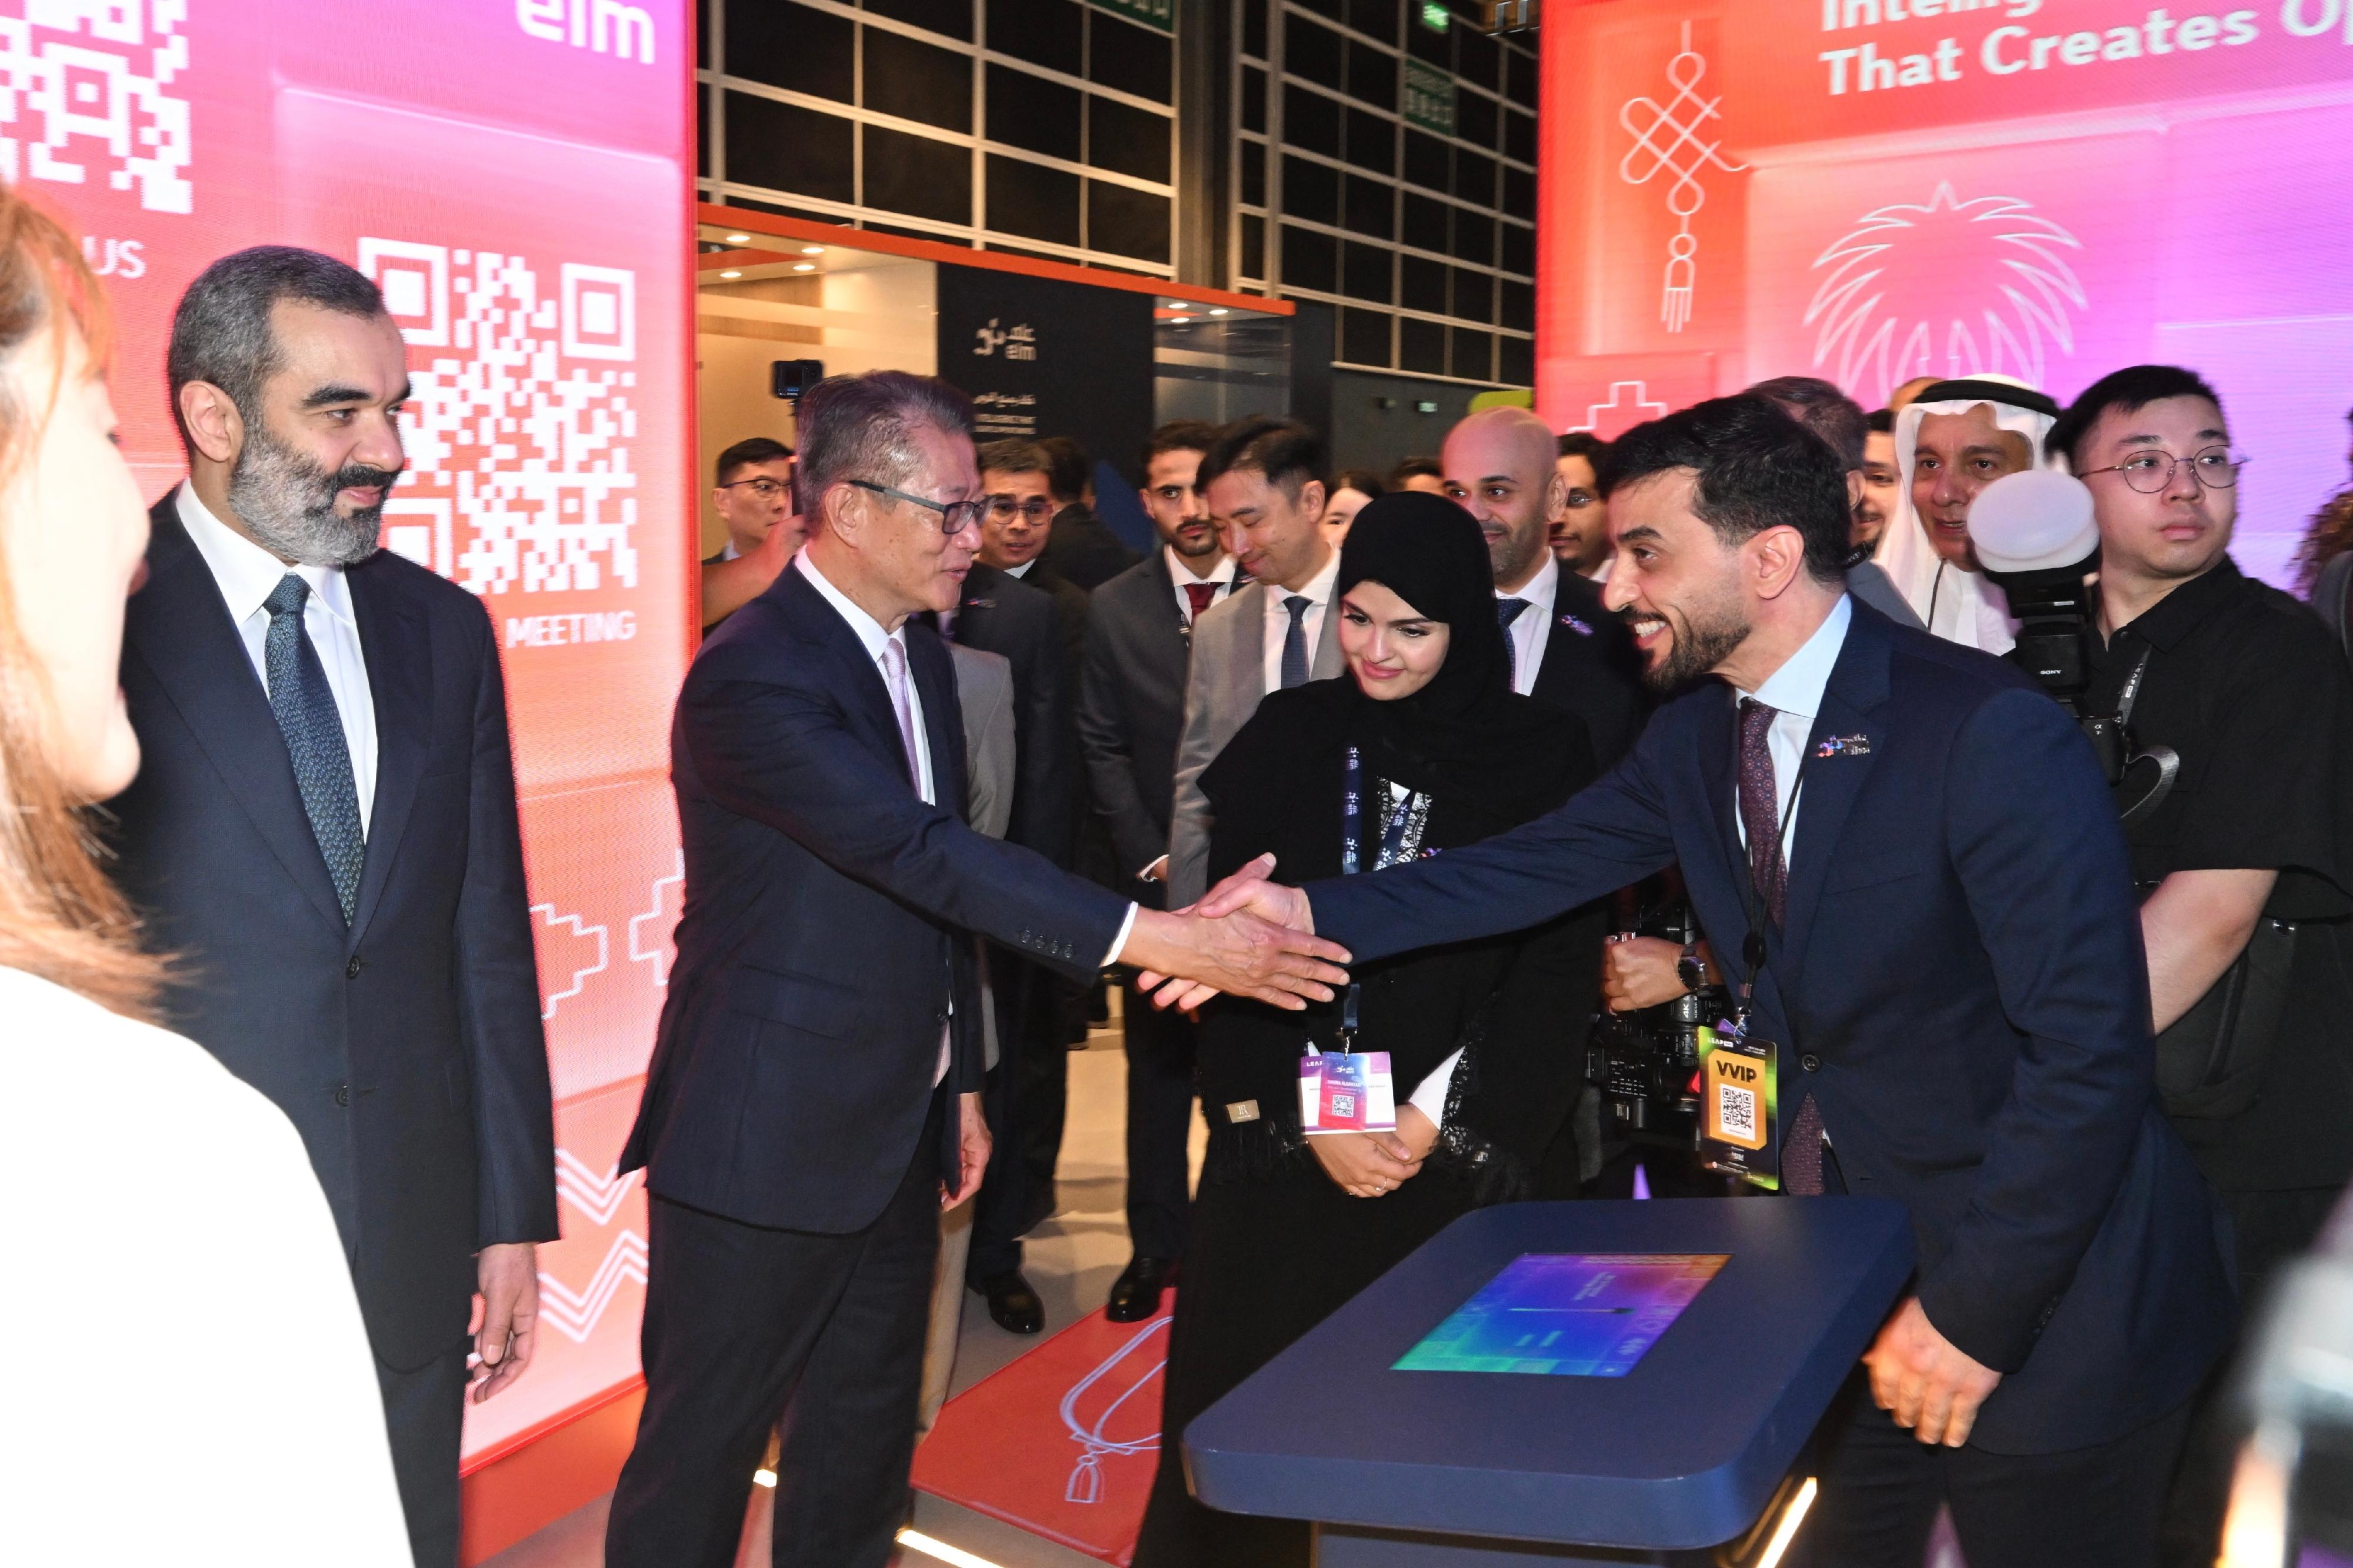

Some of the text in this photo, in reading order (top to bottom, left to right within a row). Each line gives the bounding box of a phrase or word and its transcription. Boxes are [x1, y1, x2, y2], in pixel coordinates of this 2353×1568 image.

[1819, 37, 1963, 95] That
[1981, 8, 2259, 74] Creates
[505, 610, 638, 649] MEETING
[1717, 1060, 1757, 1083] VVIP
